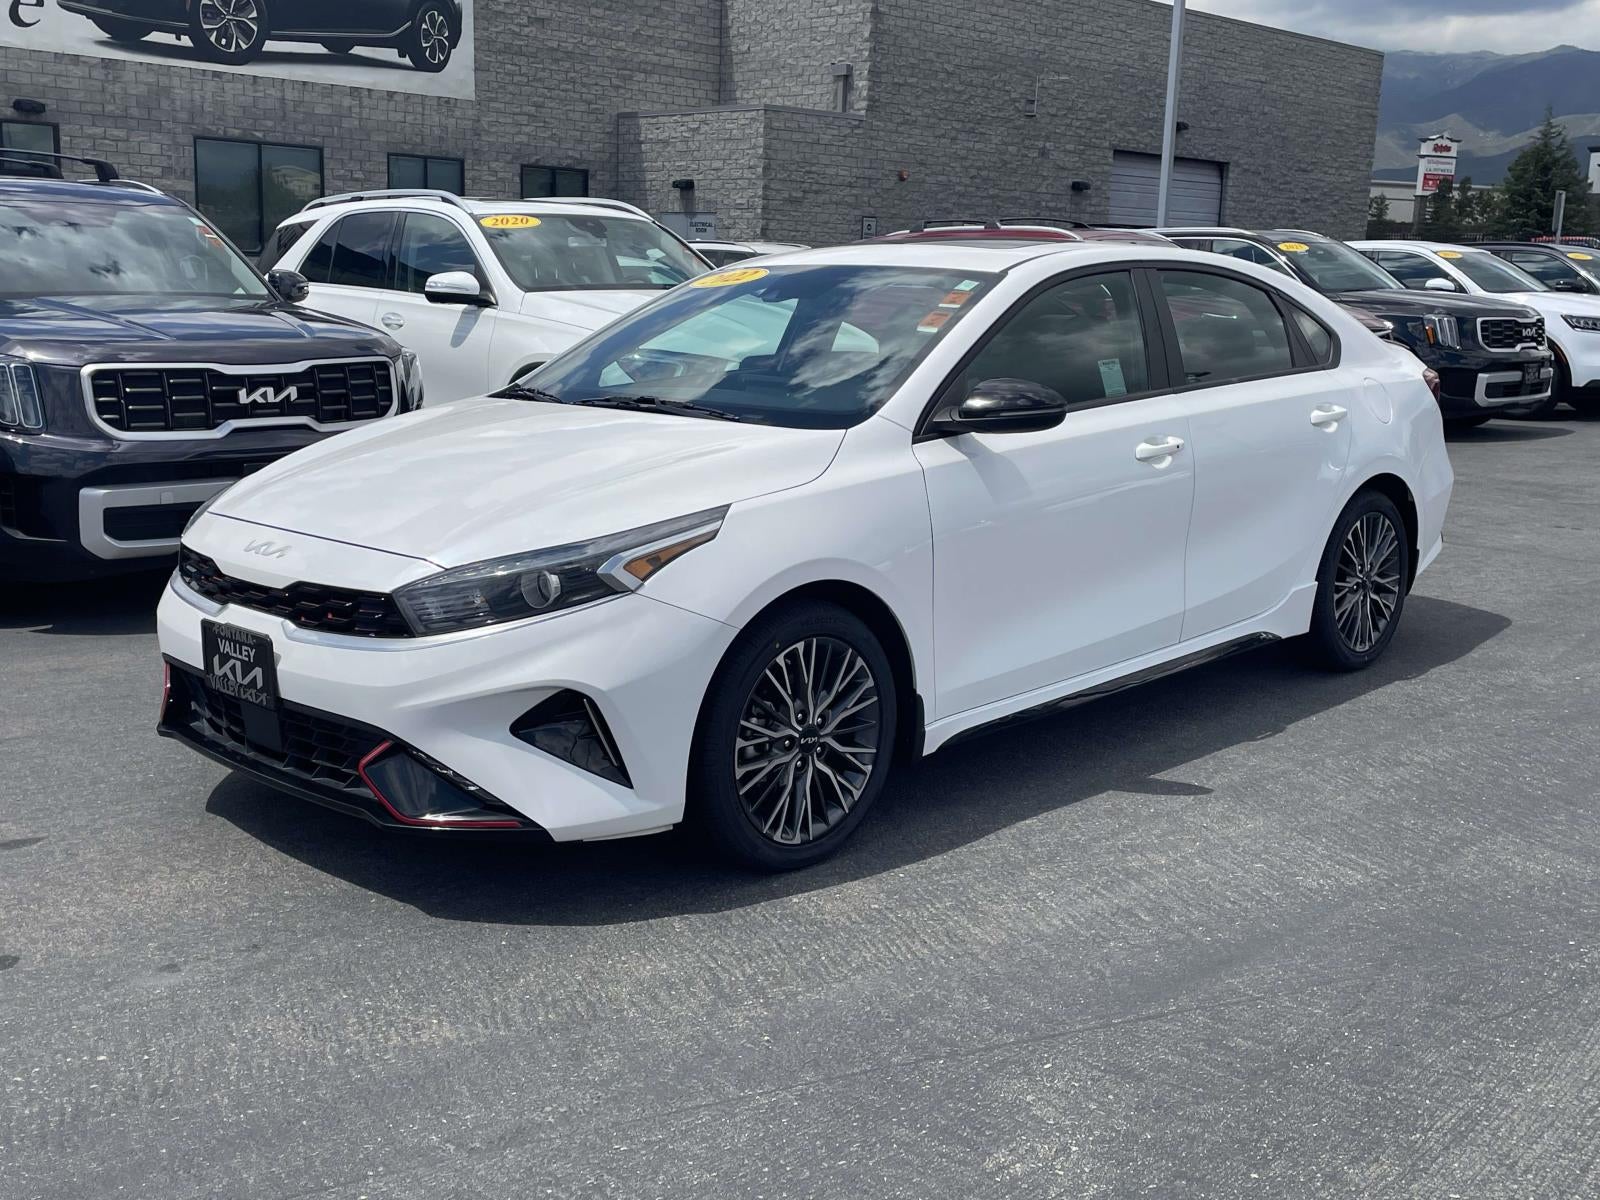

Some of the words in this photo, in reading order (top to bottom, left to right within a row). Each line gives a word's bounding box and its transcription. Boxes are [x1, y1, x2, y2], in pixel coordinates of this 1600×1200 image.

[491, 216, 529, 226] 2020
[238, 385, 298, 404] KIA
[243, 539, 293, 559] KIA
[217, 637, 256, 663] VALLEY
[213, 654, 264, 690] KIA
